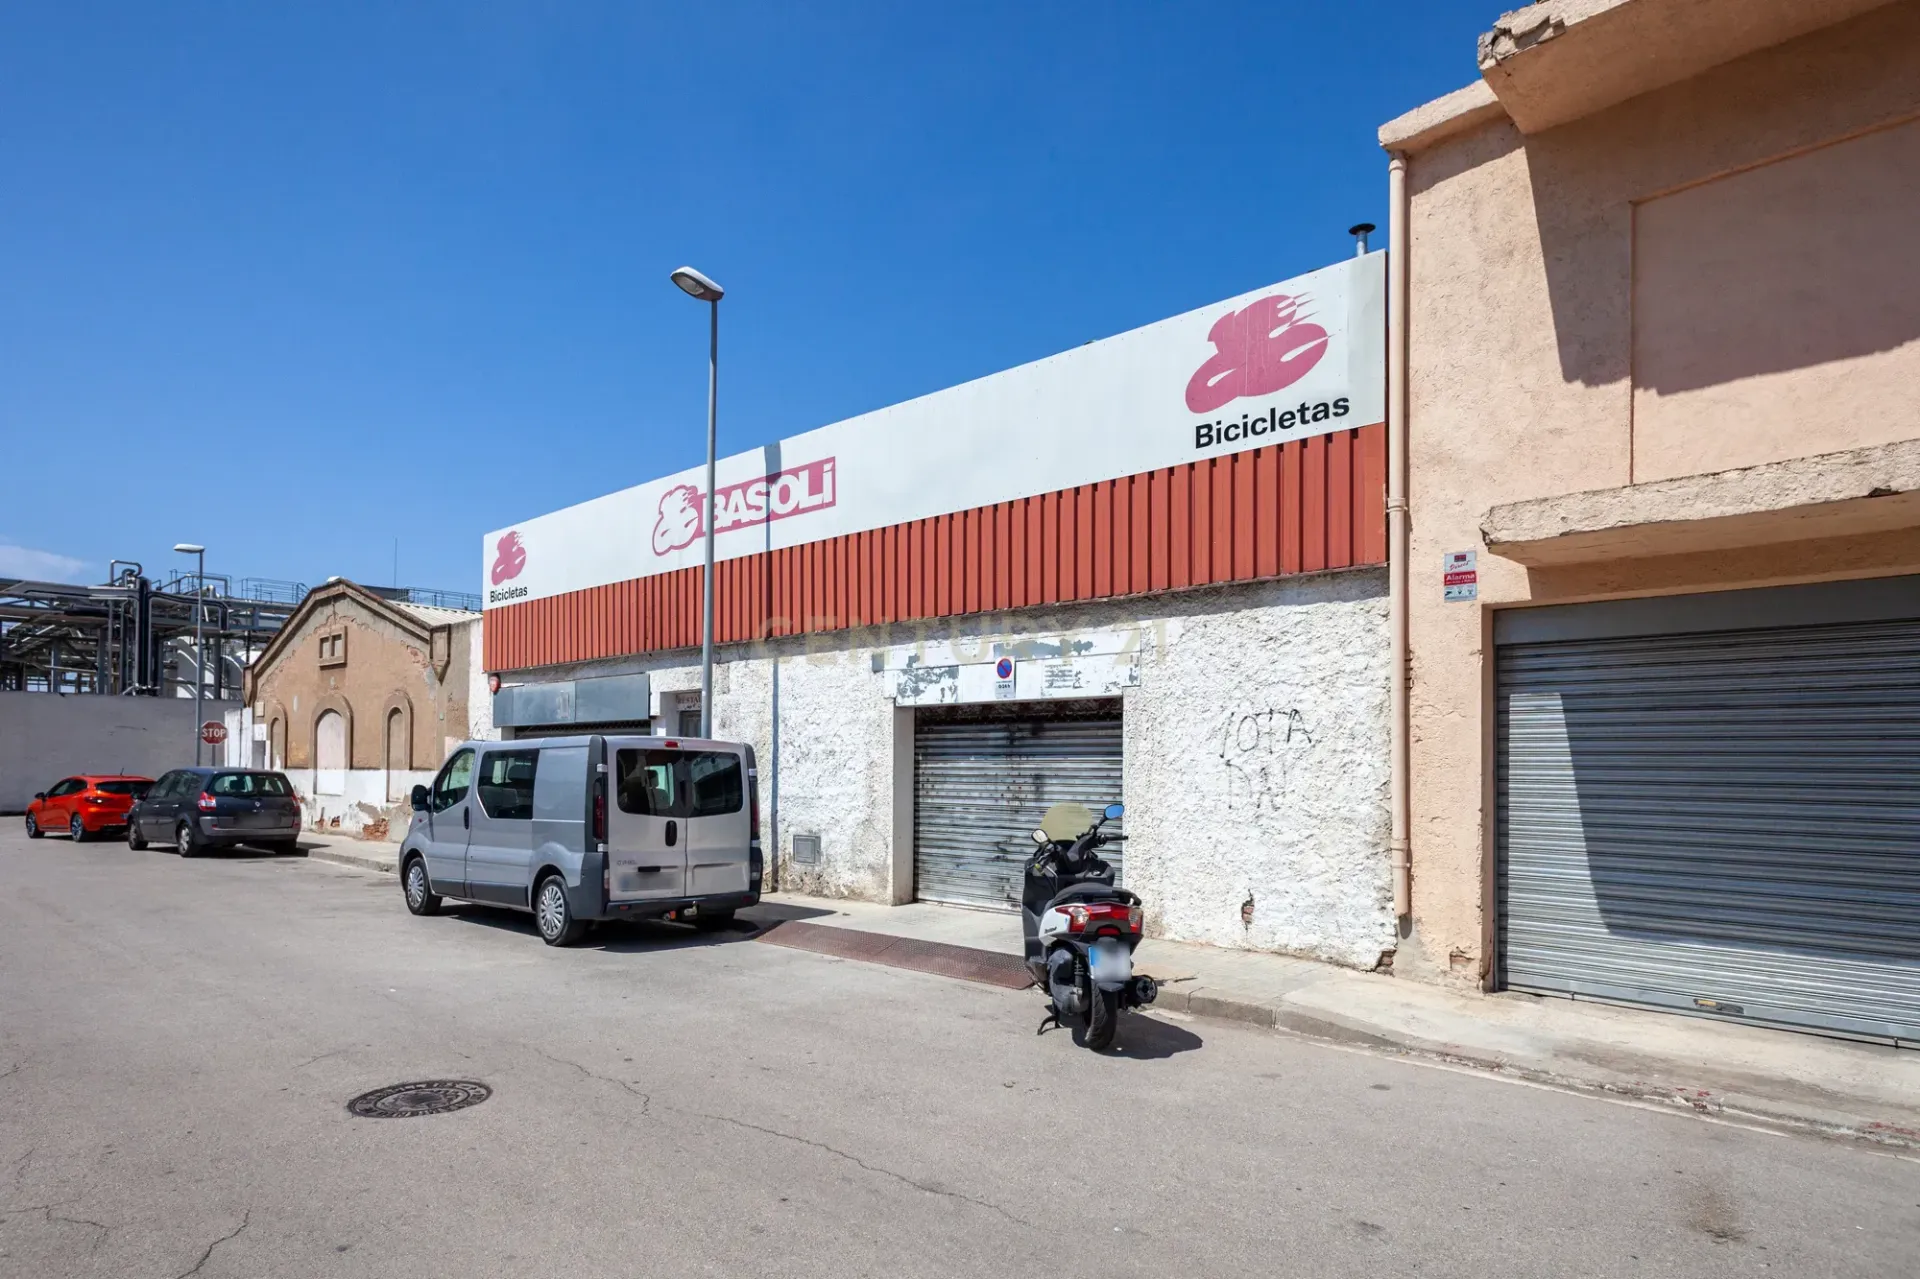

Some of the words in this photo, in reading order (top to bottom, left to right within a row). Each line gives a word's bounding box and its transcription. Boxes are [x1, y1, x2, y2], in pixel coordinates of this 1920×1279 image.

[1195, 397, 1350, 449] Bicicletas
[1446, 573, 1475, 581] Alarma
[490, 586, 528, 603] Bicicletas
[202, 728, 226, 738] STOP
